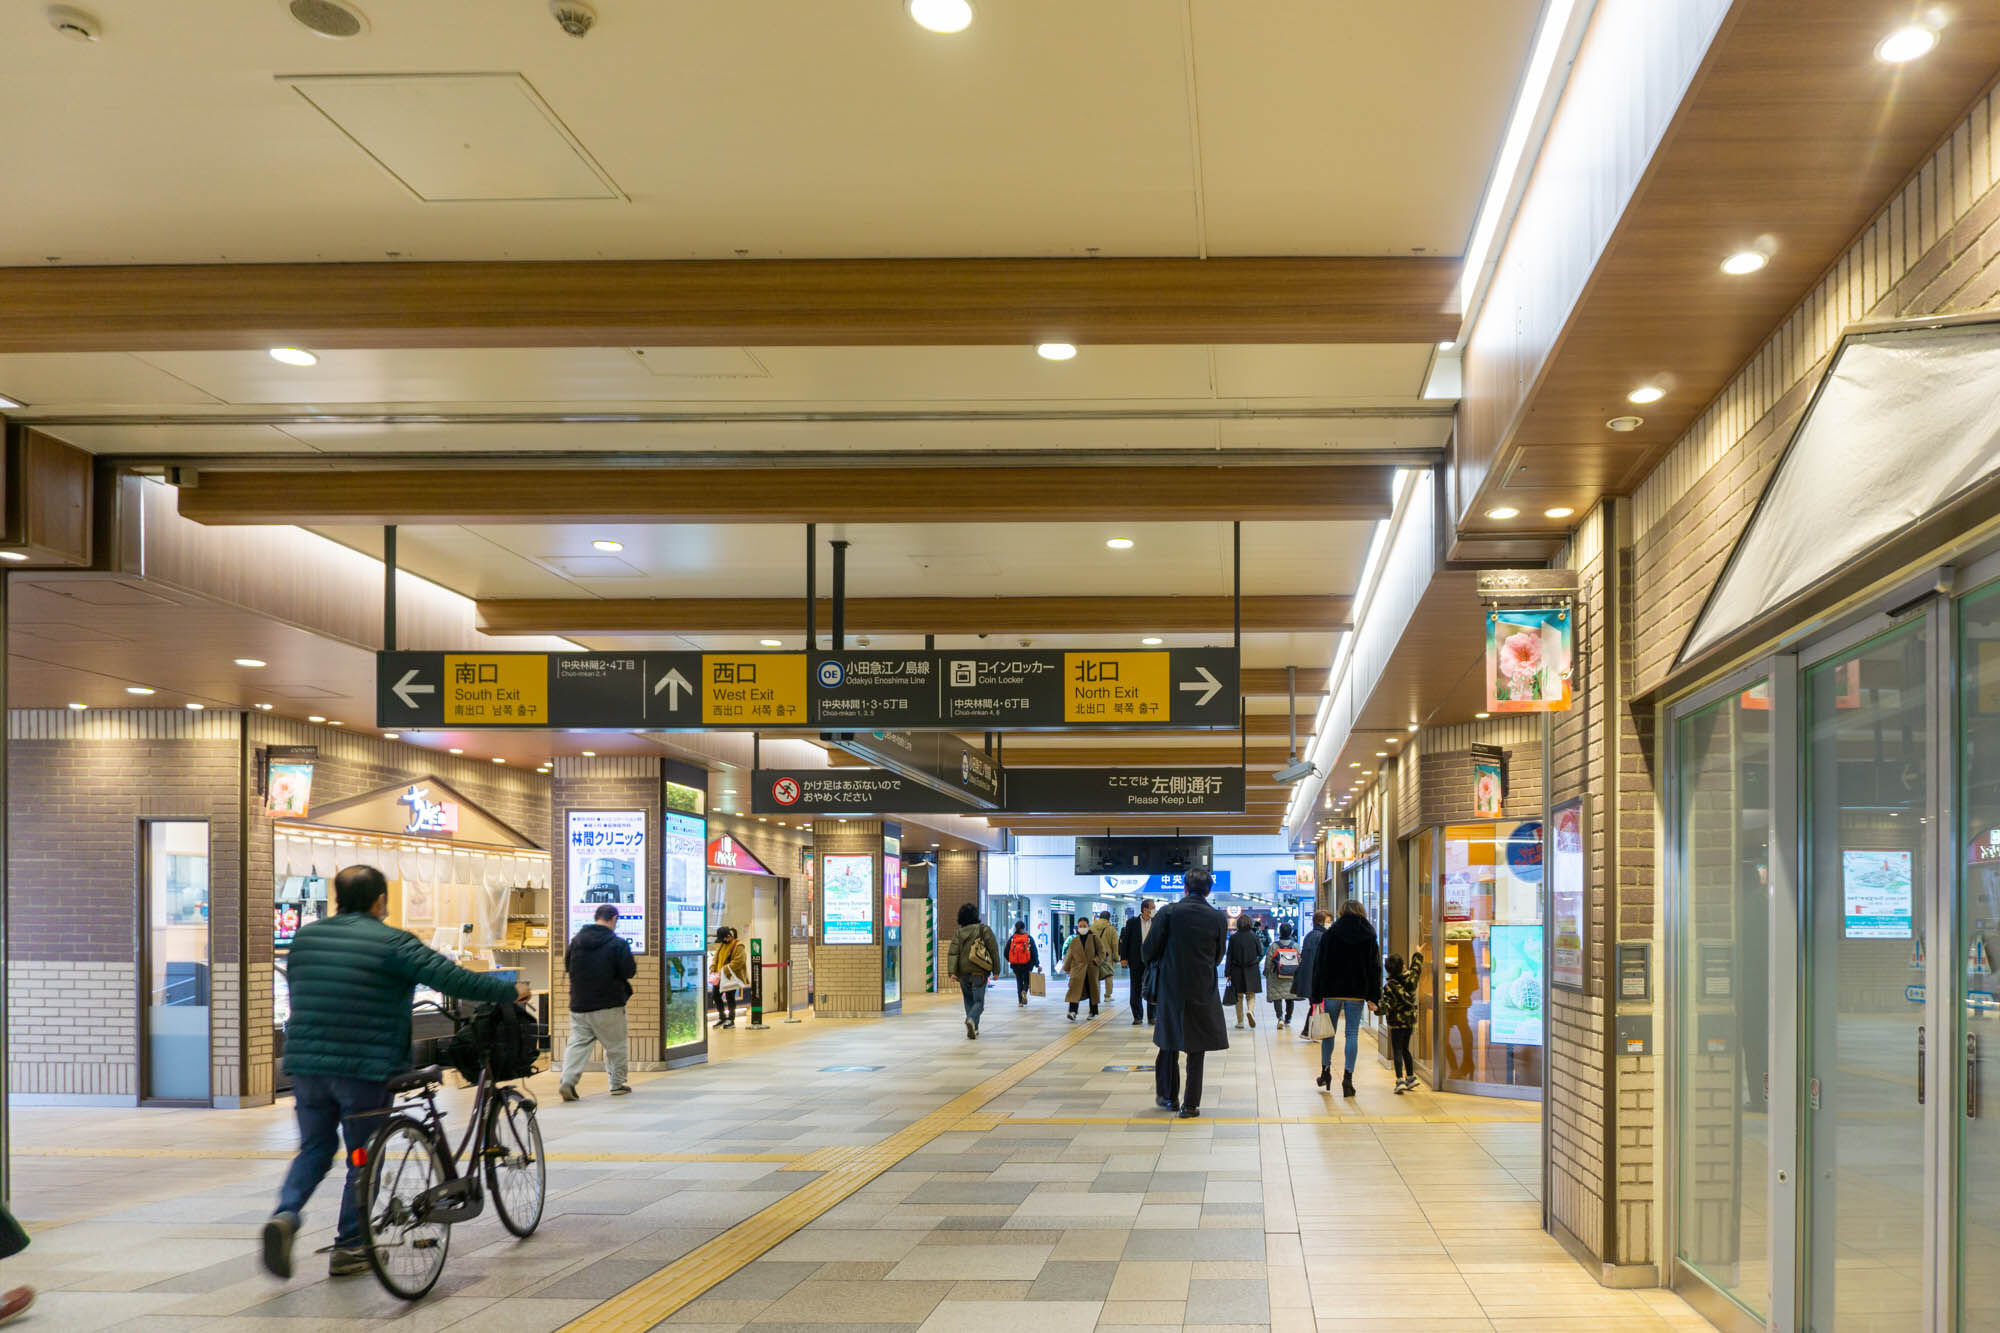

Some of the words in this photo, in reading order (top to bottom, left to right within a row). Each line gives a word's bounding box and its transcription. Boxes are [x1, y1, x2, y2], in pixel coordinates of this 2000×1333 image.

[455, 662, 498, 684] 南口
[712, 662, 757, 684] 西口
[845, 661, 930, 675] 小田急江ノ島線
[978, 661, 1055, 674] コインロッカー
[1074, 659, 1119, 682] 北口
[823, 670, 838, 679] OE
[874, 676, 909, 685] Enoshima
[910, 676, 926, 685] Line
[978, 675, 996, 685] Coin
[998, 675, 1024, 684] Locker
[455, 688, 492, 701] South
[497, 688, 520, 701] Exit
[712, 688, 746, 701] West
[750, 688, 774, 701] Exit
[1075, 686, 1110, 699] North
[1114, 686, 1138, 699] Exit
[454, 704, 485, 717] 南出口
[712, 704, 744, 717] 西出口
[1075, 702, 1106, 715] 北出口
[803, 780, 901, 791] かけ足はあぶないので
[1108, 776, 1149, 787] ここでは
[1151, 775, 1223, 794] 左側通行
[803, 792, 873, 802] おやめください
[1128, 795, 1159, 804] Please
[1161, 795, 1185, 806] Keep
[1187, 795, 1204, 804] Left
[571, 830, 644, 847] 林間クリニック
